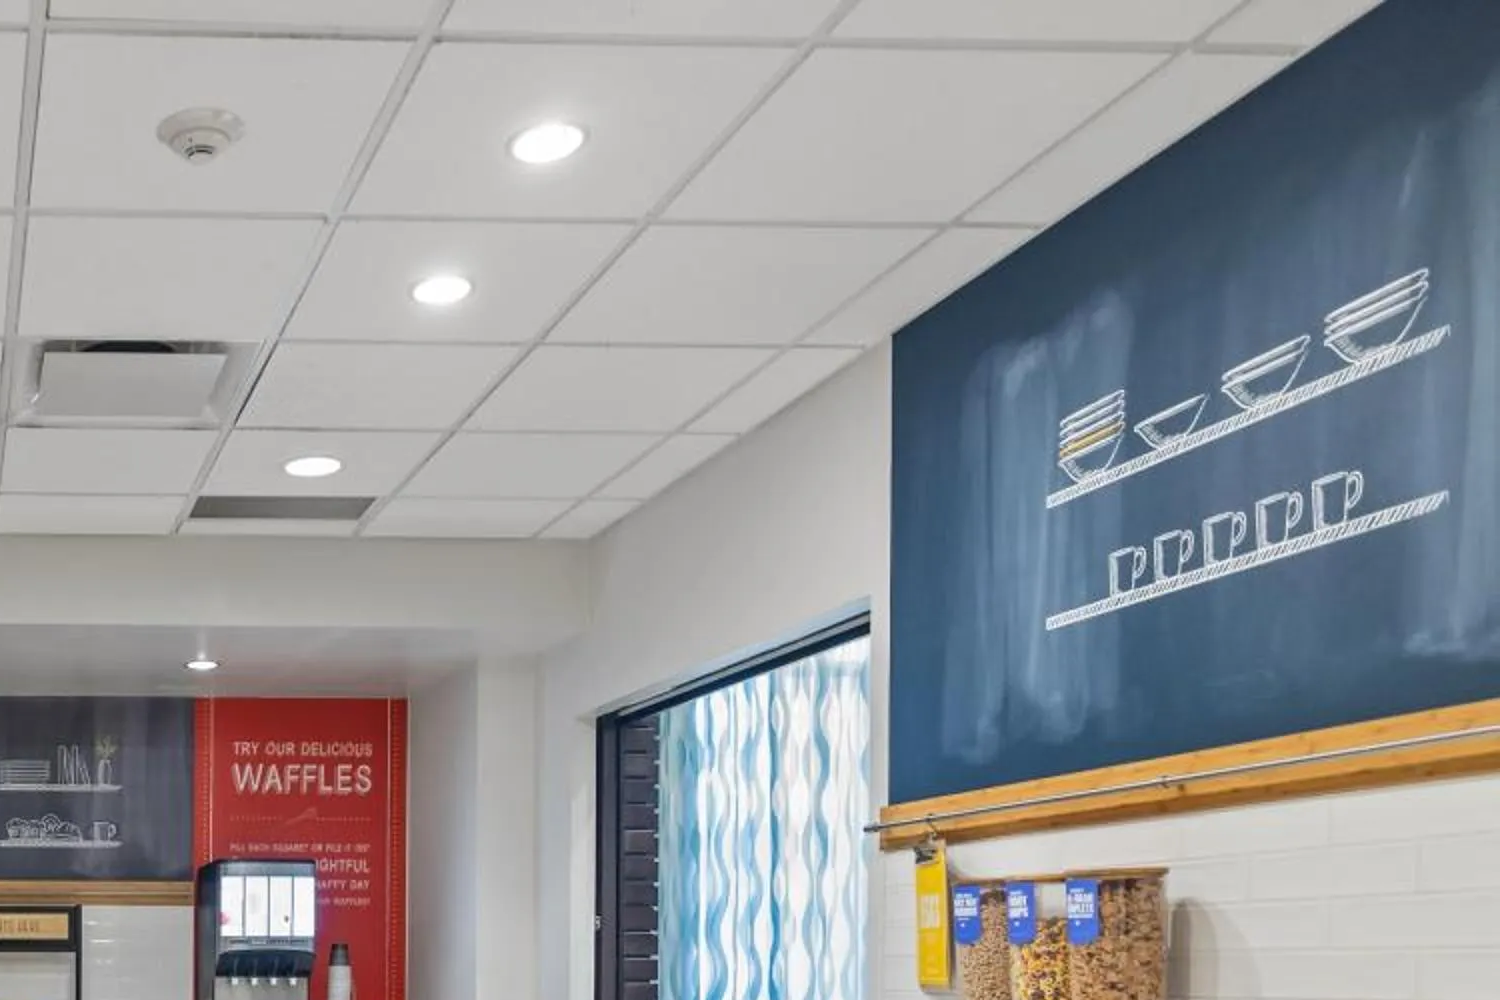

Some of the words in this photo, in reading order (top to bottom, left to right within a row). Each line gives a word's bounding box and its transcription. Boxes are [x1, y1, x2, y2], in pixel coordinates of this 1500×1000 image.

[233, 741, 260, 756] TRY
[264, 742, 295, 756] OUR
[301, 742, 373, 757] DELICIOUS
[230, 762, 373, 796] WAFFLES
[315, 858, 370, 874] IGHTFUL
[349, 879, 370, 890] DAY
